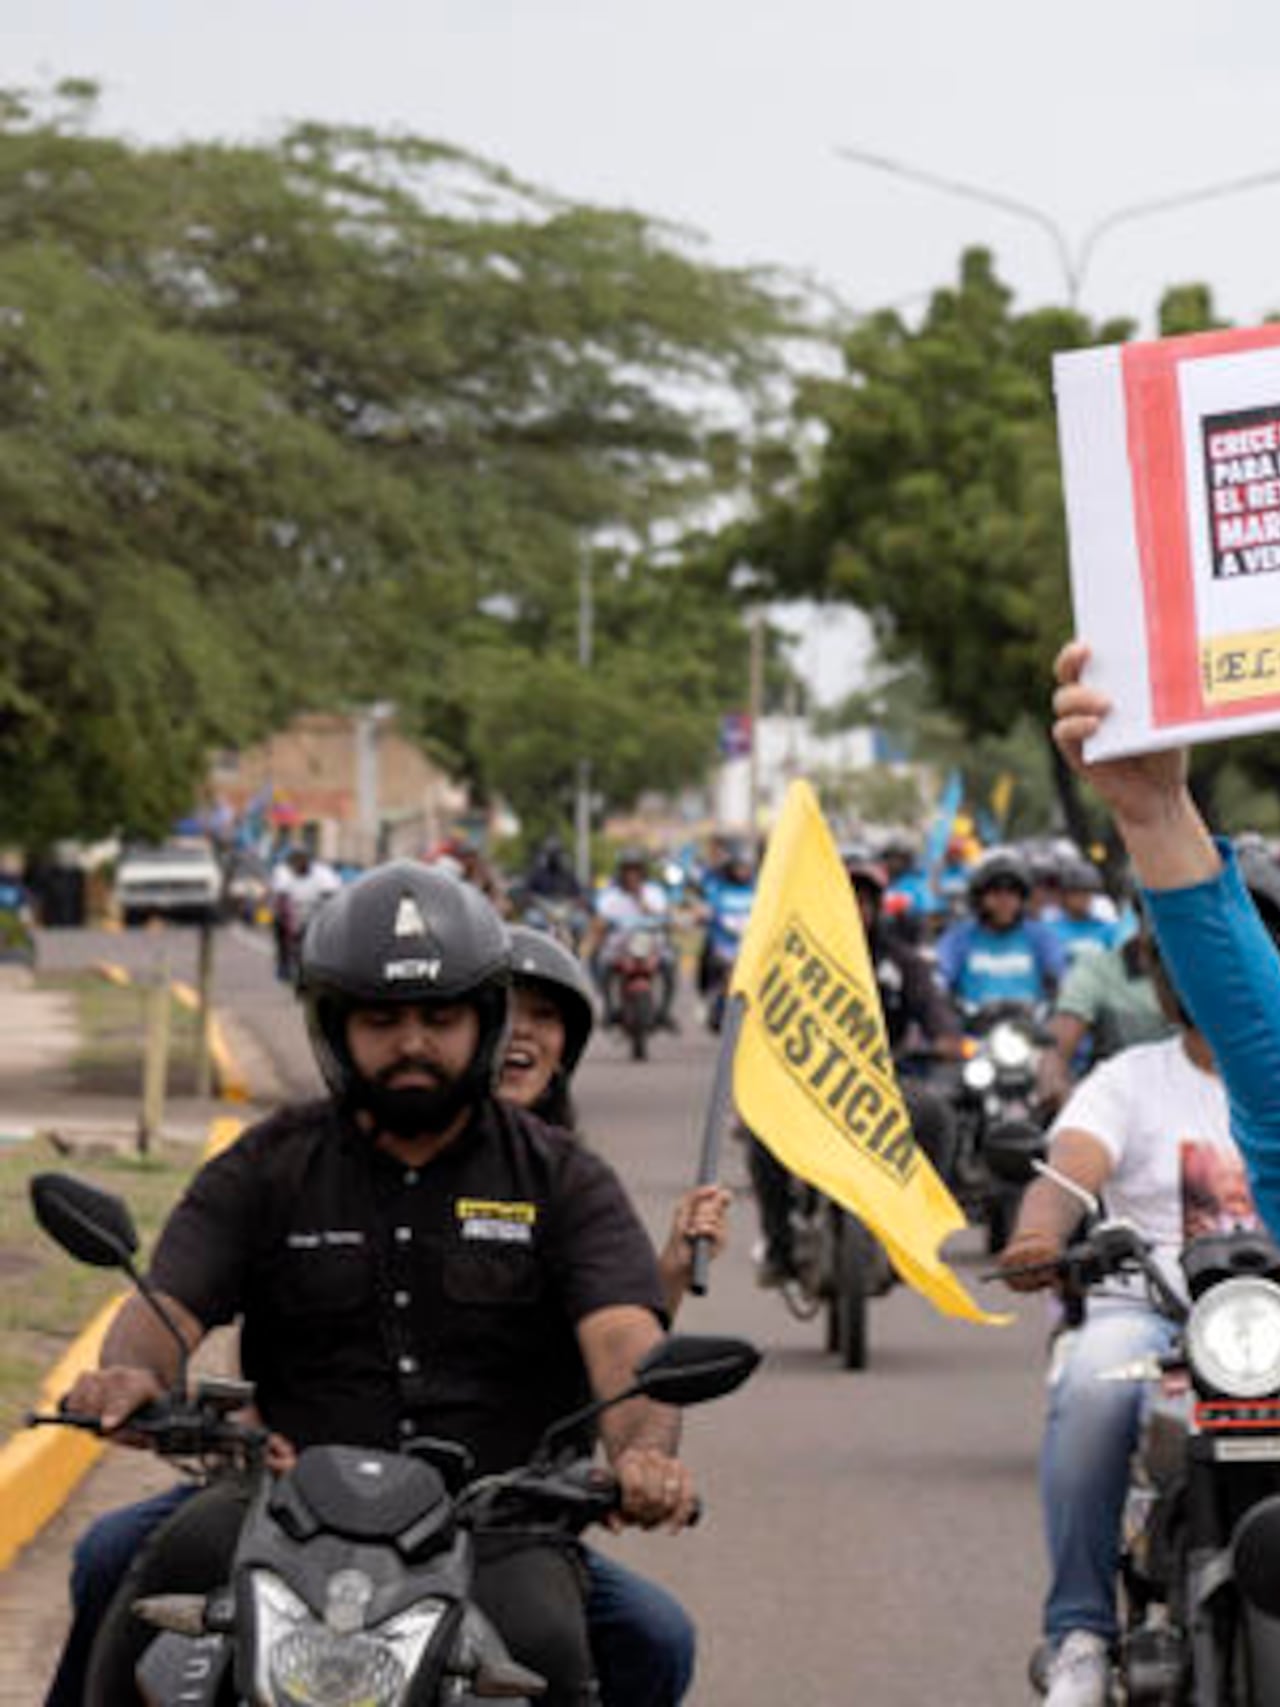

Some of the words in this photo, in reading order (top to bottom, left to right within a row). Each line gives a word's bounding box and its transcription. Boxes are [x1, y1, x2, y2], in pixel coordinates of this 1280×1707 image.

[1210, 424, 1277, 458] CRECE
[1214, 452, 1274, 486] PARA
[1215, 488, 1243, 514] EL
[1221, 553, 1240, 577] A
